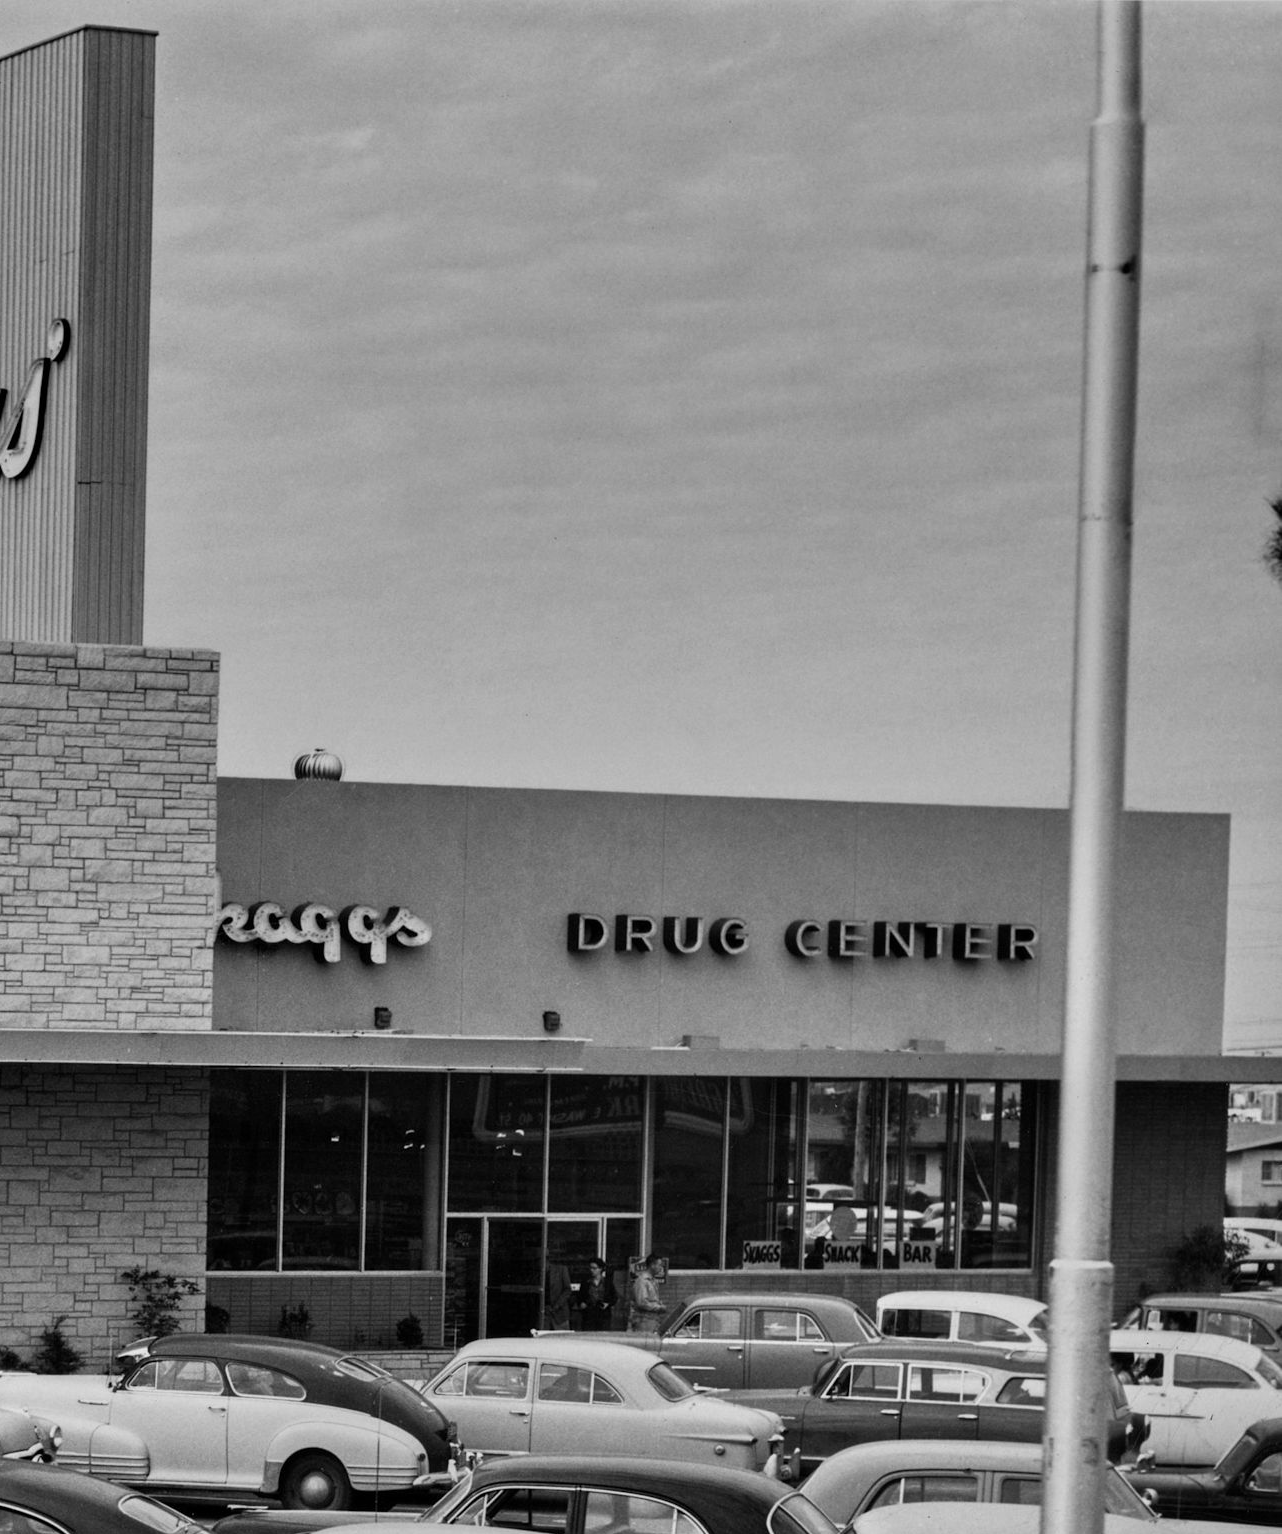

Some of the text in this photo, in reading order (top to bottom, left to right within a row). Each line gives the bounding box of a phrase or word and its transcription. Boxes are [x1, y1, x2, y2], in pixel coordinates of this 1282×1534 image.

[567, 913, 1039, 961] DRUG CENTER
[743, 1243, 781, 1264] SKAGGS
[824, 1244, 861, 1264] SNACK
[903, 1243, 932, 1263] BAR
